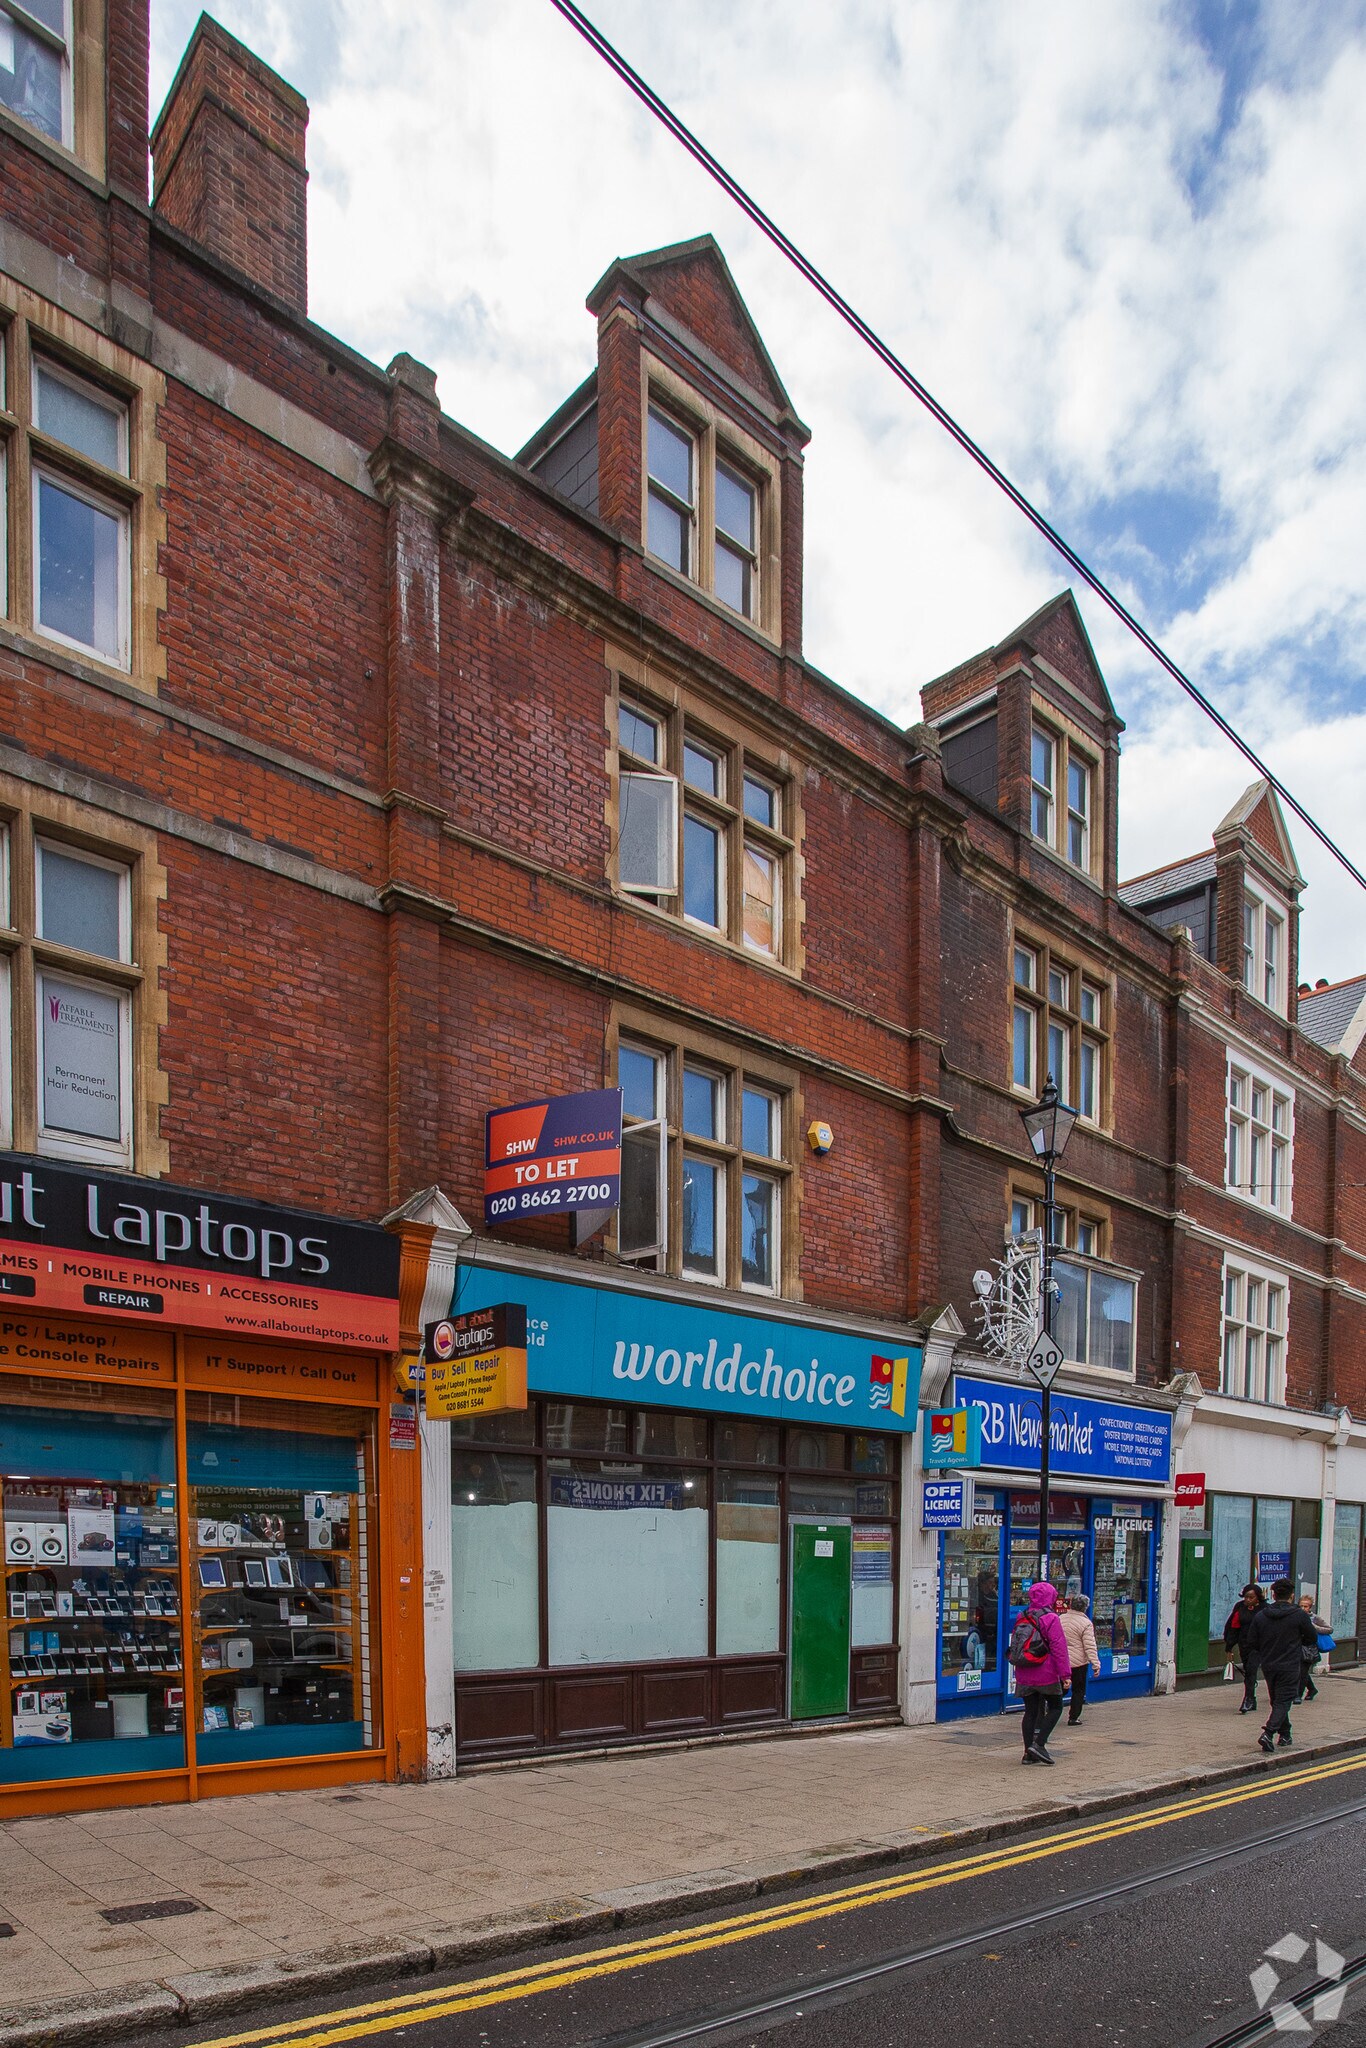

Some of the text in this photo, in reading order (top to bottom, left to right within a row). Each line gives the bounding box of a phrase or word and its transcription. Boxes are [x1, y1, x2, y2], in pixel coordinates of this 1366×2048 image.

[59, 1002, 95, 1019] AFFABLE
[59, 1012, 115, 1033] TREATMENTS
[55, 1066, 106, 1086] Permanent
[47, 1077, 117, 1101] Hair Reduction
[506, 1138, 536, 1155] SHW
[554, 1130, 614, 1147] SHW.CO.UK
[514, 1158, 579, 1183] TO LET
[491, 1183, 611, 1215] 020 8662 2700
[87, 1183, 330, 1278] laptops
[63, 1262, 128, 1284] MOBILE
[133, 1273, 200, 1294] PHONES
[219, 1286, 319, 1311] ACCESSORIES
[99, 1291, 150, 1308] REPAIR
[224, 1314, 389, 1345] www.allaboutlaptops.co.uk
[455, 1309, 494, 1331] all about
[2, 1322, 28, 1338] PC
[44, 1327, 107, 1348] Laptop
[455, 1327, 494, 1349] laptops
[15, 1344, 89, 1364] Console
[95, 1352, 160, 1372] Repairs
[1032, 1350, 1058, 1369] 30
[206, 1355, 222, 1368] IT
[227, 1356, 287, 1376] Support
[300, 1366, 327, 1380] Call
[332, 1369, 357, 1382] Out
[431, 1355, 500, 1381] Buy Sell Repair
[612, 1338, 856, 1407] worldchoice
[434, 1382, 446, 1392] Apple
[450, 1379, 464, 1389] Laptop
[468, 1375, 482, 1385] Phone
[482, 1373, 497, 1383] Repair
[438, 1392, 450, 1401] Game
[450, 1390, 467, 1399] Console
[471, 1387, 477, 1396] TV
[478, 1385, 492, 1394] Repair
[446, 1403, 456, 1412] 020
[456, 1400, 470, 1409] 8681
[391, 1419, 415, 1429] Alarm
[960, 1397, 1005, 1445] RB
[1099, 1417, 1168, 1436] CONFECTIONERY GREETING CARDS
[1104, 1430, 1163, 1446] OYSTER TOPUP TRAVEL CARDS
[1104, 1442, 1162, 1457] MOBILE TOPUP PHONE CARDS
[947, 1456, 968, 1464] Agents
[1114, 1455, 1153, 1468] NATIONAL LOTTERY
[925, 1486, 961, 1497] OFF
[1177, 1484, 1202, 1495] Sun
[925, 1499, 961, 1511] LICENCE
[925, 1513, 961, 1526] Newsagents
[1094, 1517, 1153, 1532] OFF LICENCE
[966, 1673, 981, 1682] Lyca
